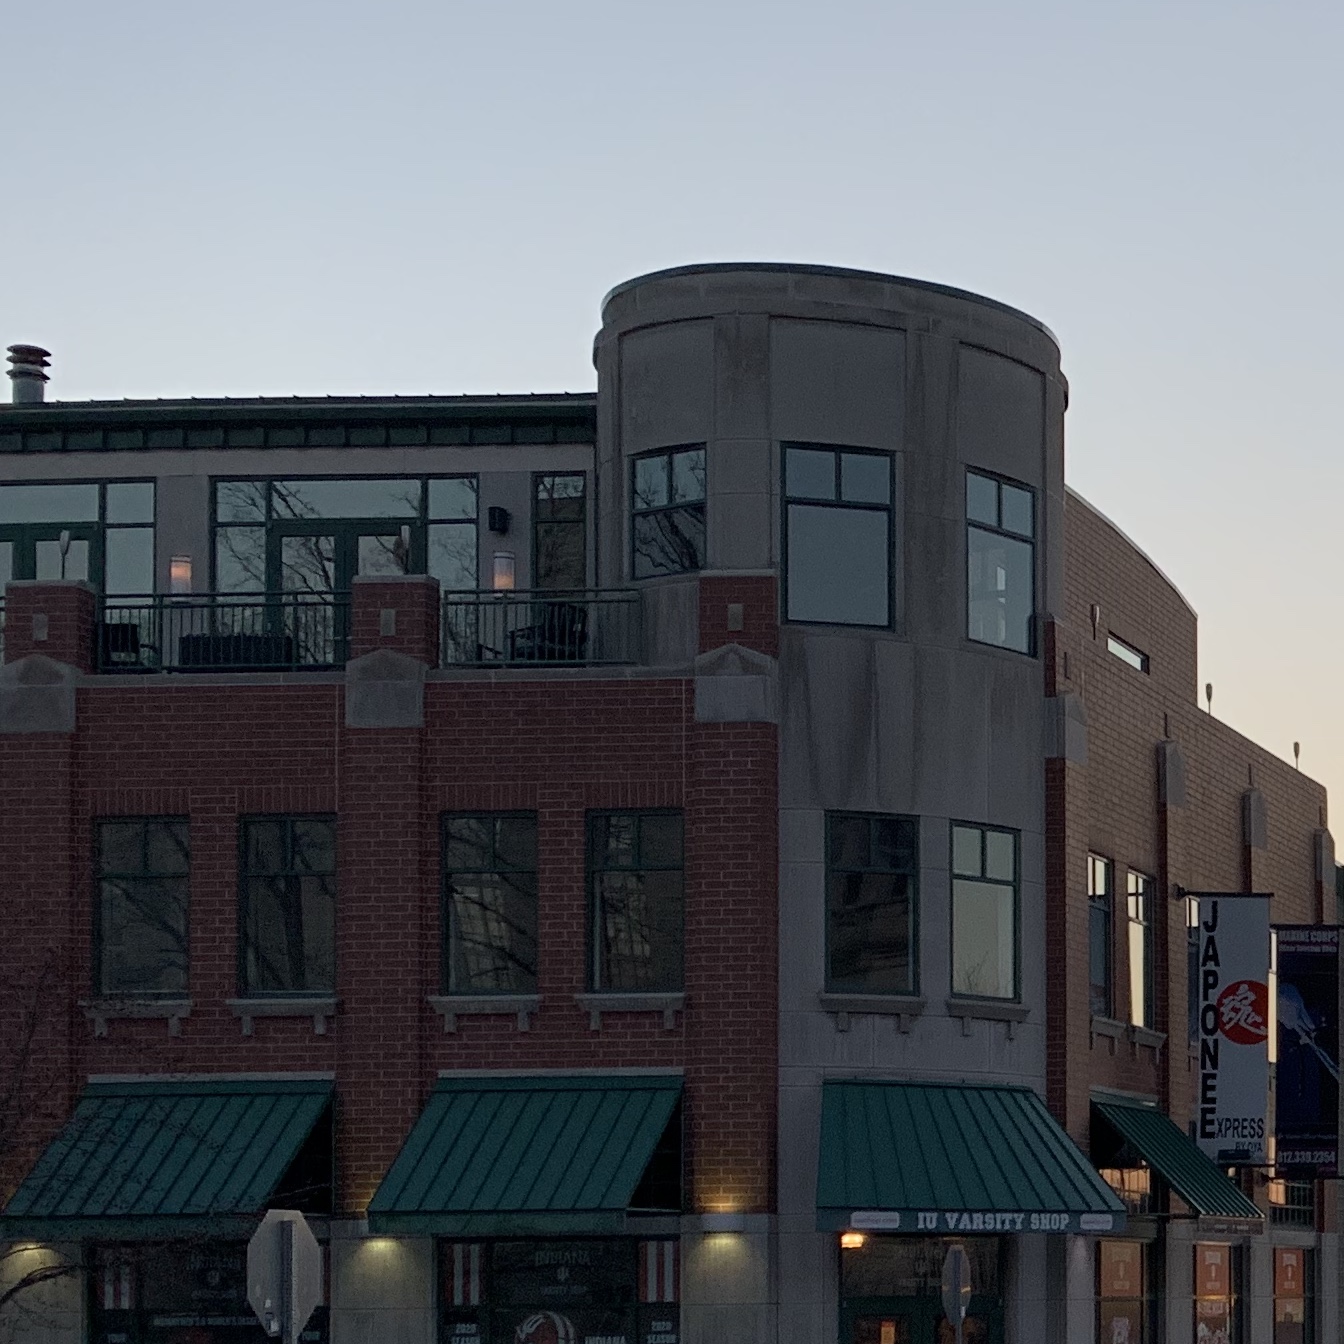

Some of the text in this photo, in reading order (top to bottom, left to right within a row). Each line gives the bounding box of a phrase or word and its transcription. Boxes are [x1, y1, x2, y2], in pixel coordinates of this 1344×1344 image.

[1201, 900, 1220, 1139] JAPONEE
[917, 1211, 1070, 1231] IU VARSITY SHOP
